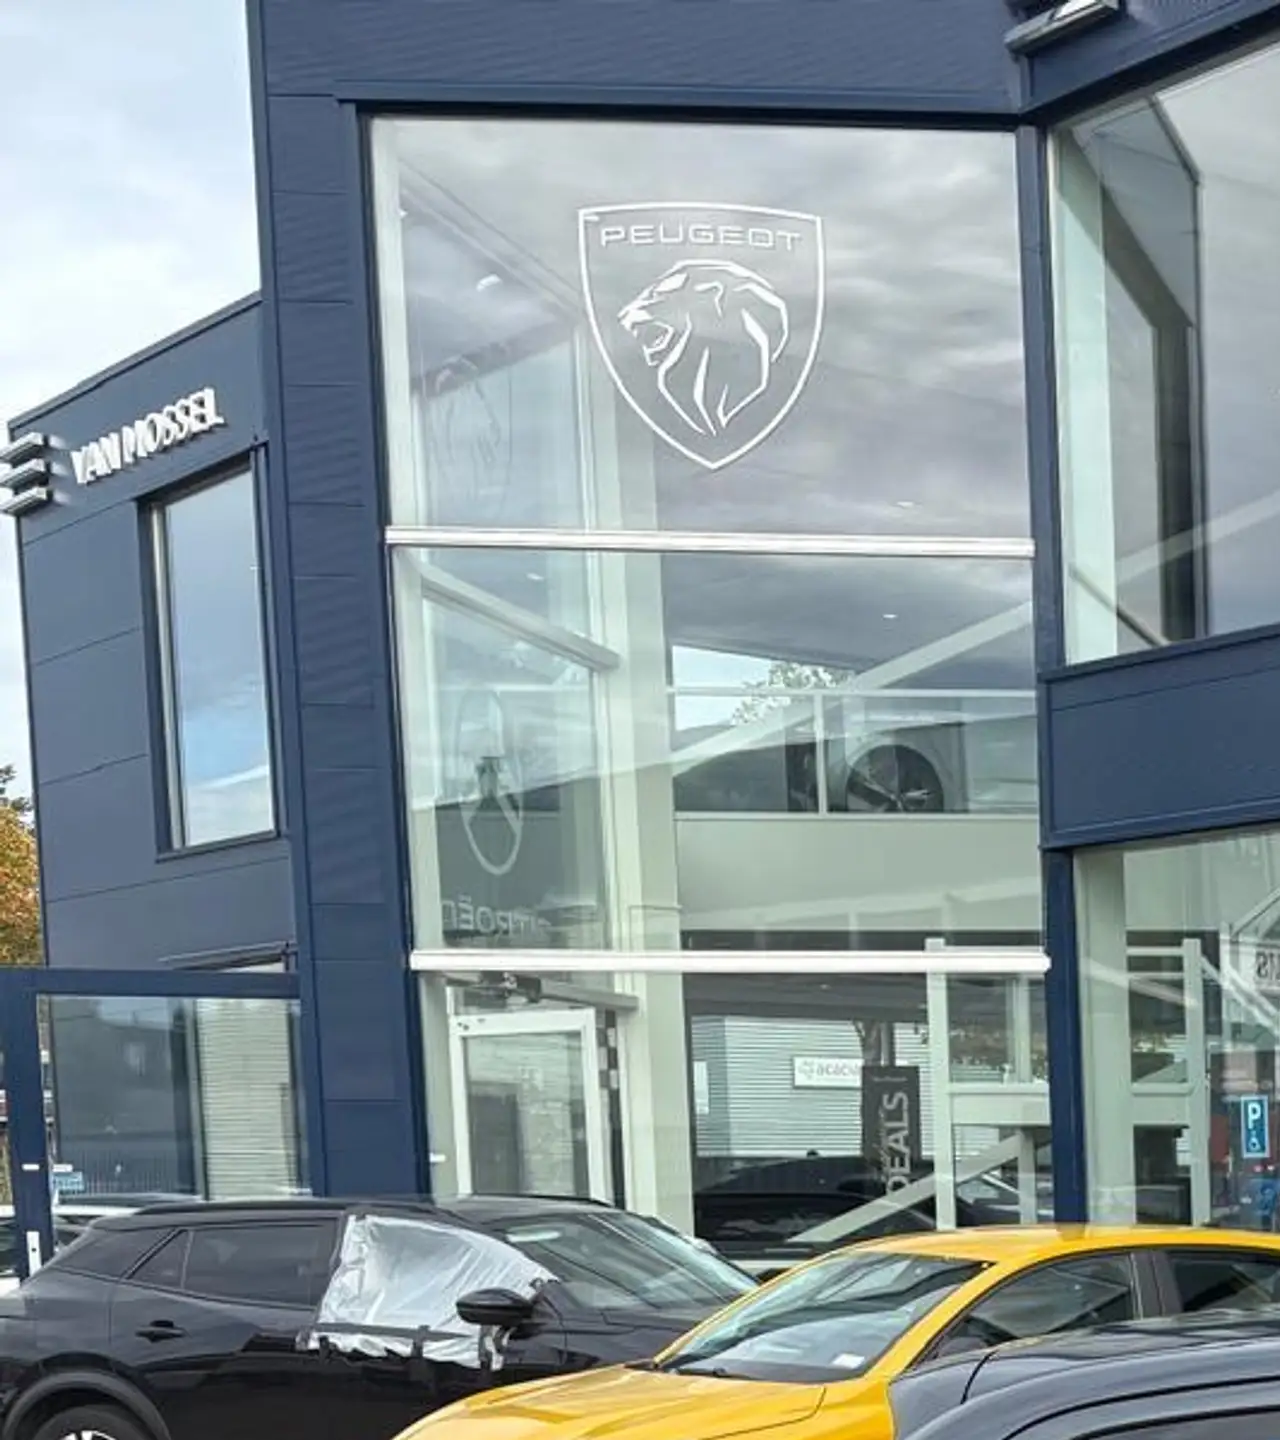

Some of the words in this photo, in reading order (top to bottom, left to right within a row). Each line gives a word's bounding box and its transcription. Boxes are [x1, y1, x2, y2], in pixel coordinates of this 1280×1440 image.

[601, 222, 800, 251] PEUGEOT
[70, 432, 122, 484] VAN
[121, 387, 225, 464] MOSSEL
[1248, 1102, 1261, 1130] P
